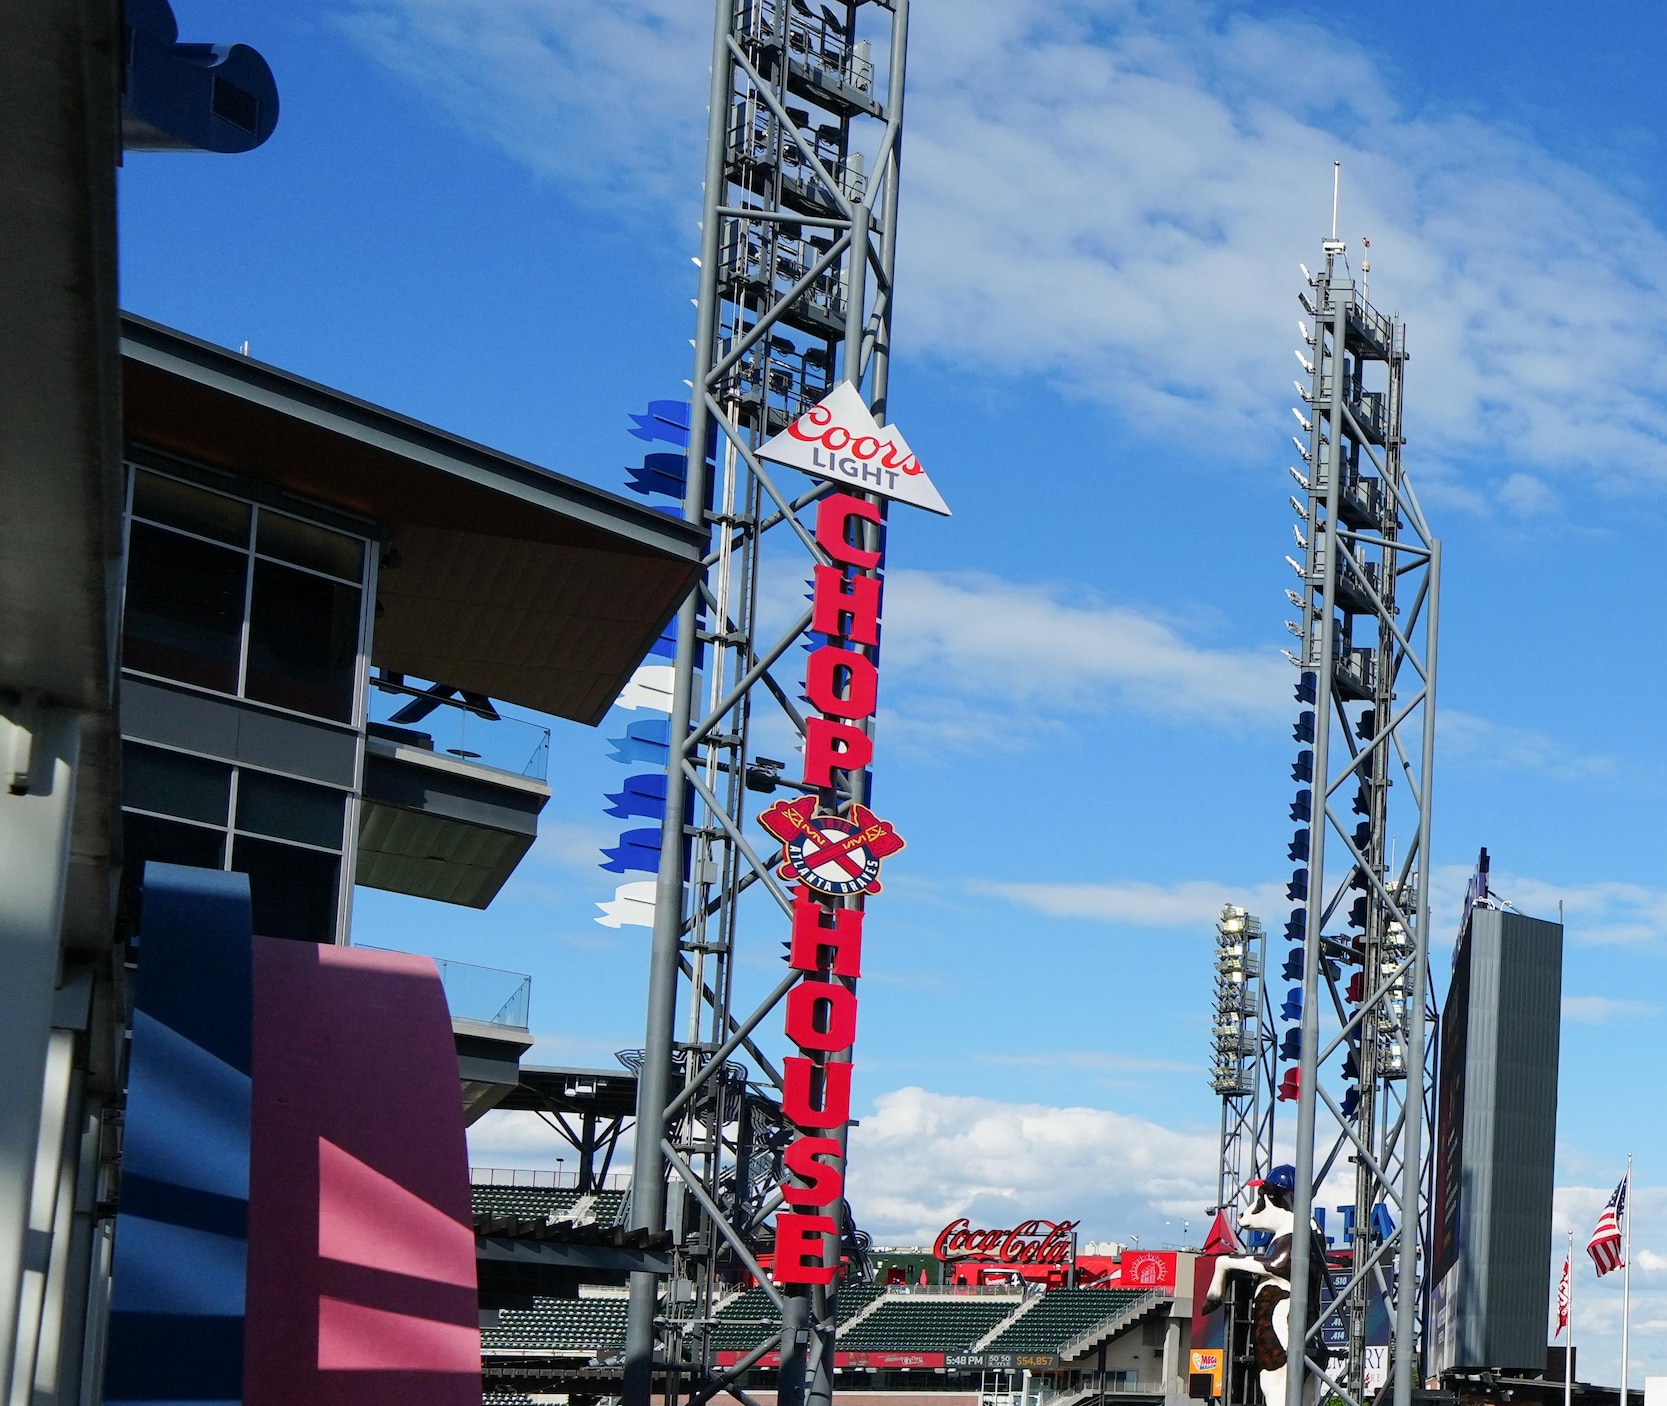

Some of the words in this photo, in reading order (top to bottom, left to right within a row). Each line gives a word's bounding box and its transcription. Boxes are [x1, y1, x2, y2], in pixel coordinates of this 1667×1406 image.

[787, 404, 925, 476] Coors
[813, 447, 900, 489] LIGHT
[802, 492, 883, 789] CHOP
[790, 845, 832, 893] ATLANTA
[840, 860, 879, 893] BRAVES
[772, 892, 865, 1285] HOUSE
[933, 1218, 1081, 1264] Coca-Cola
[945, 1355, 965, 1366] 5:48
[966, 1356, 983, 1366] PM
